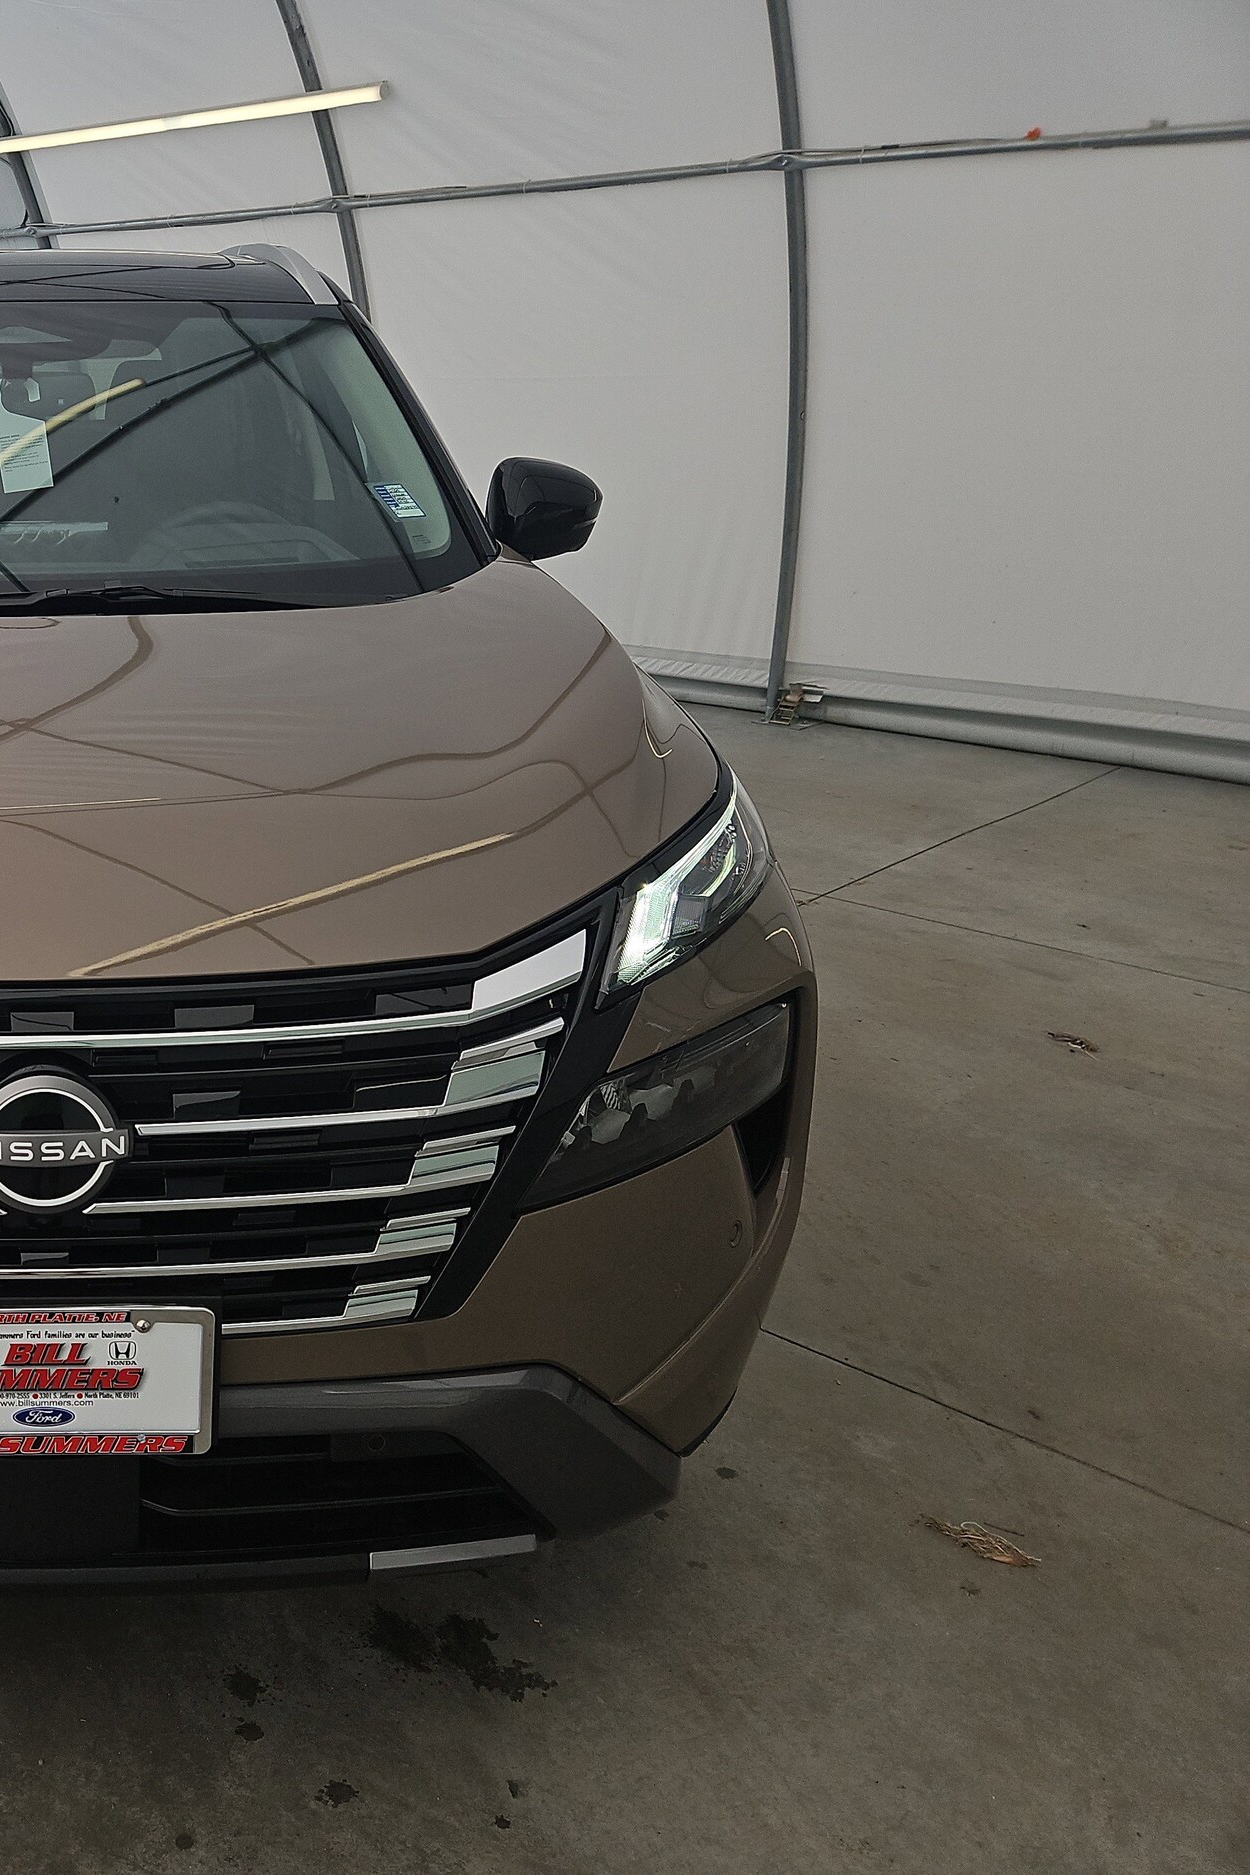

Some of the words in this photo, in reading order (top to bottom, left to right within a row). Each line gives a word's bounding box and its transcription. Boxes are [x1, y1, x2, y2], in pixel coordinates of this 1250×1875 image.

[101, 1312, 128, 1322] NE
[26, 1330, 41, 1339] Ford
[44, 1330, 72, 1339] families
[2, 1342, 91, 1366] BILL
[84, 1391, 98, 1399] North
[115, 1391, 122, 1399] NE
[25, 1409, 62, 1423] Ford
